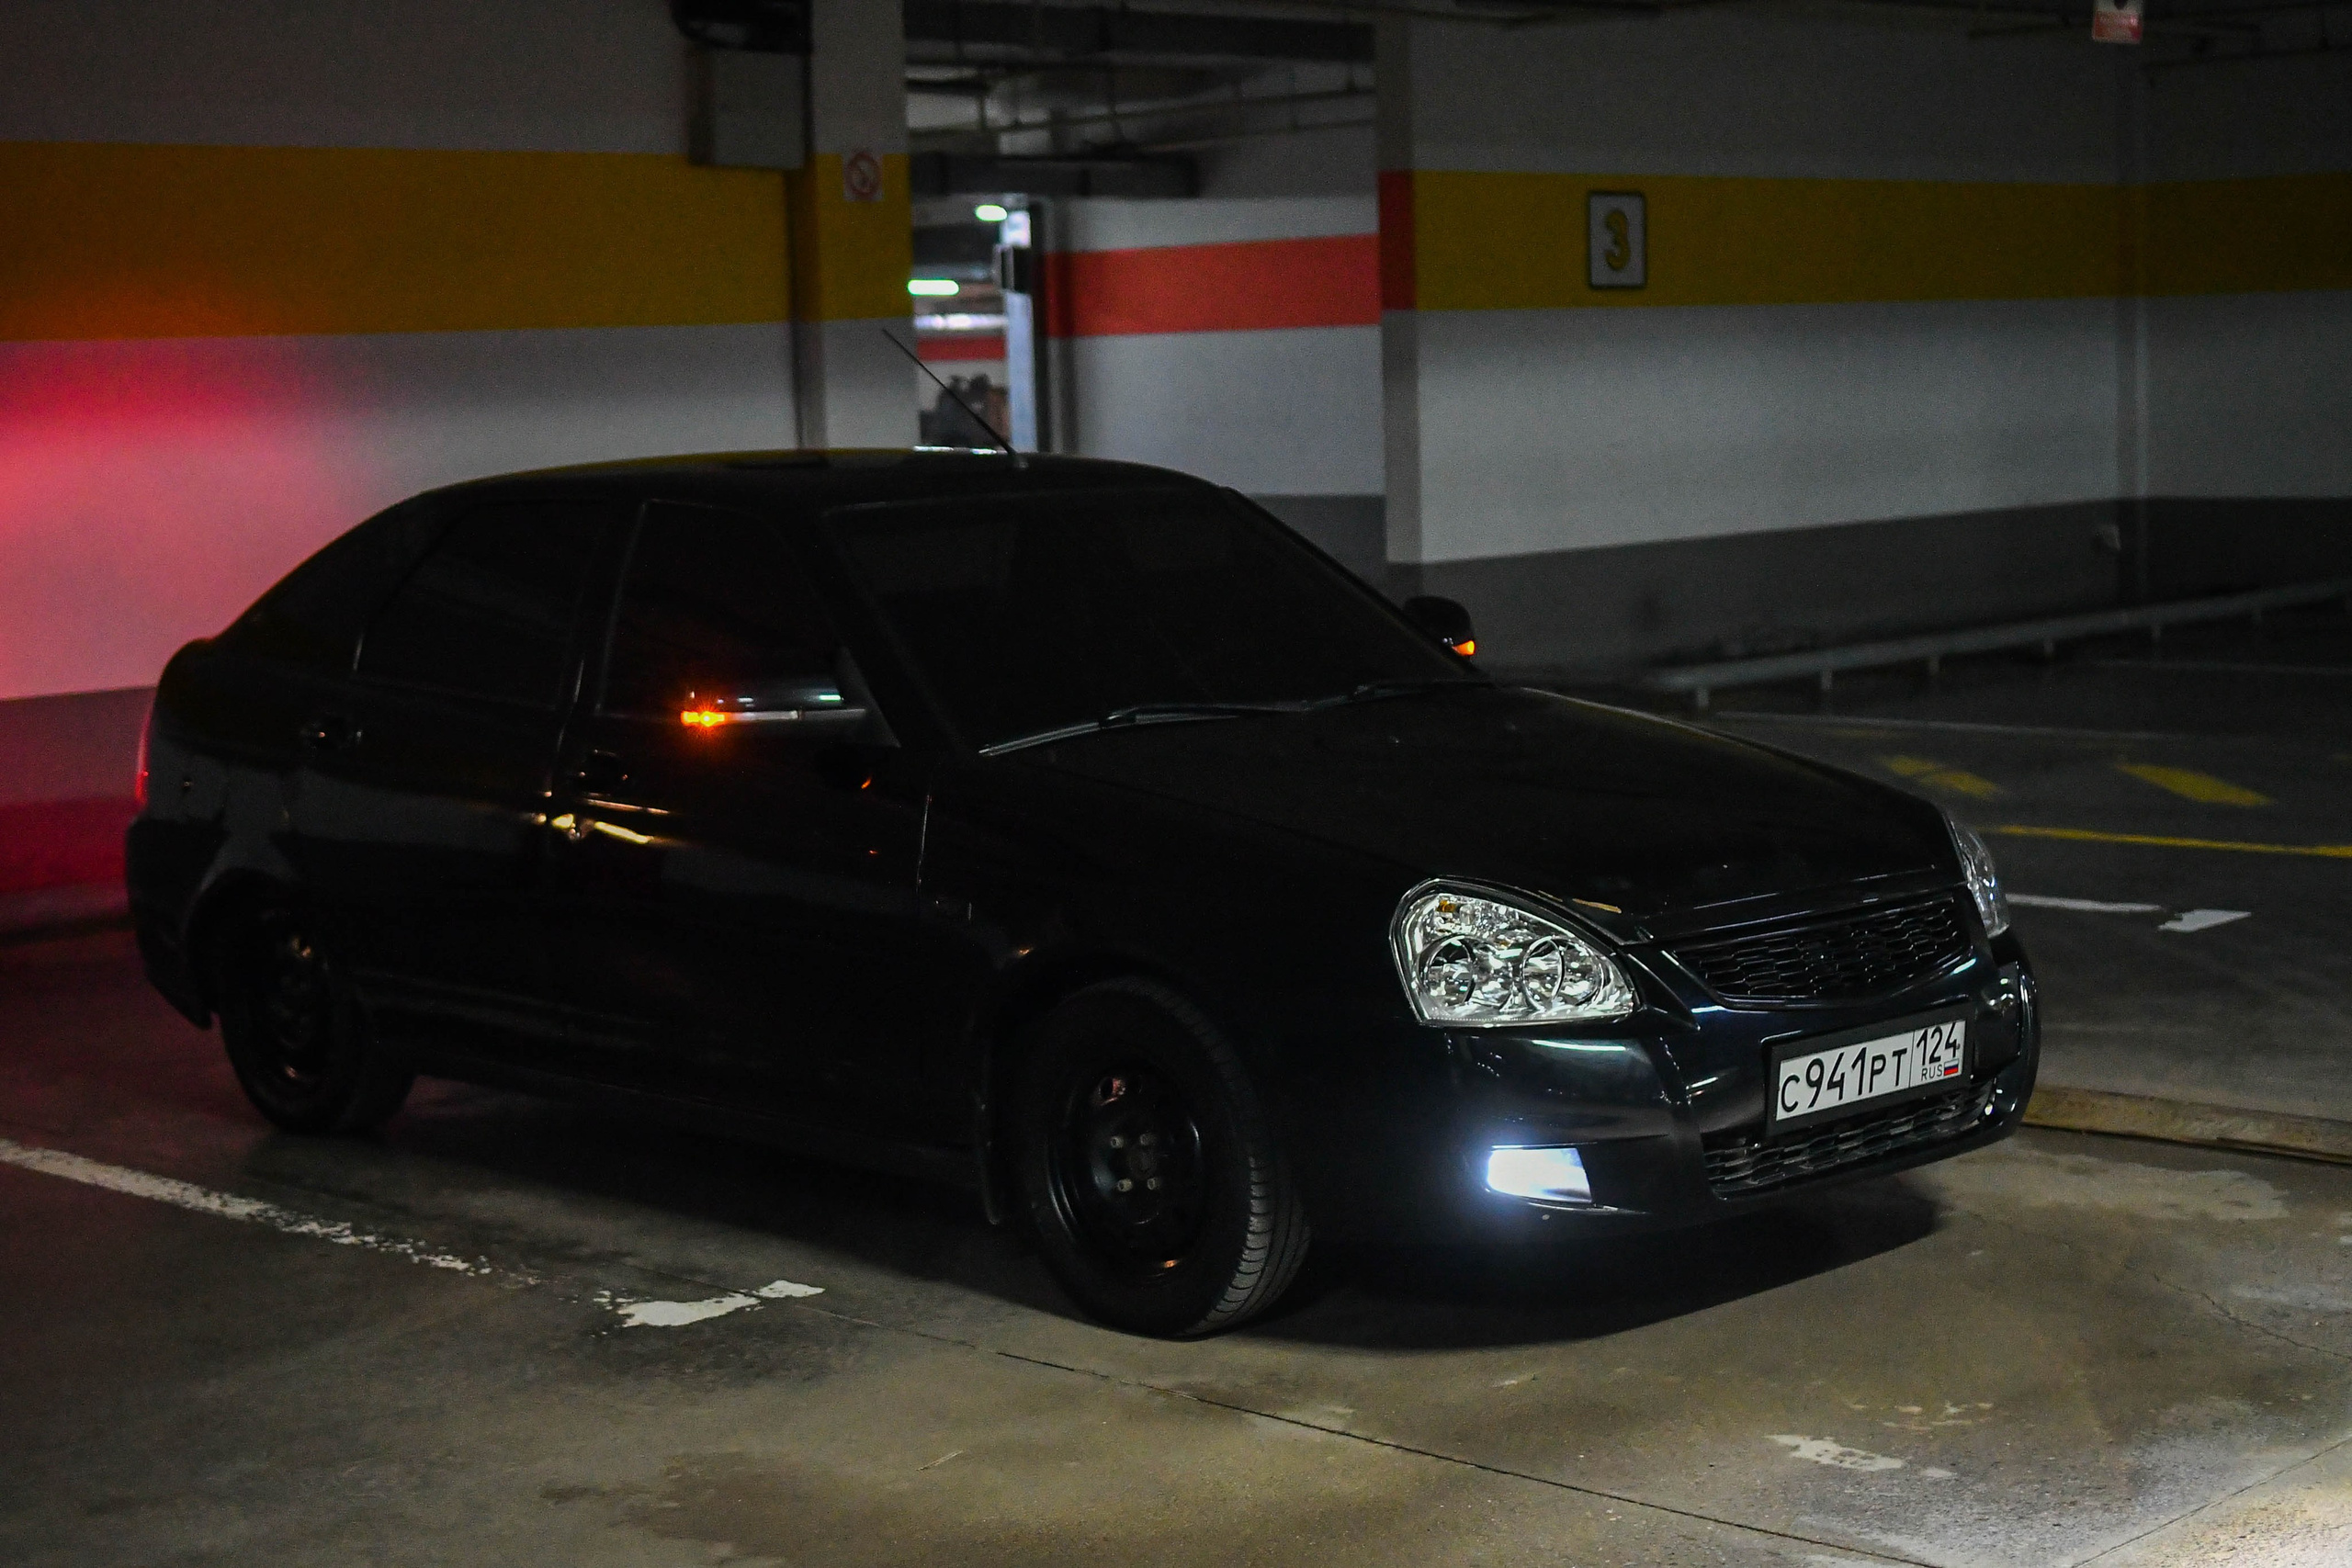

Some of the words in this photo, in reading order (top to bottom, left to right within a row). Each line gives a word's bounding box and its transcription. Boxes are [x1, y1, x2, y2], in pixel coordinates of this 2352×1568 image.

[1605, 210, 1629, 270] 3
[1916, 1021, 1959, 1066] 124
[1920, 1066, 1943, 1081] RUS
